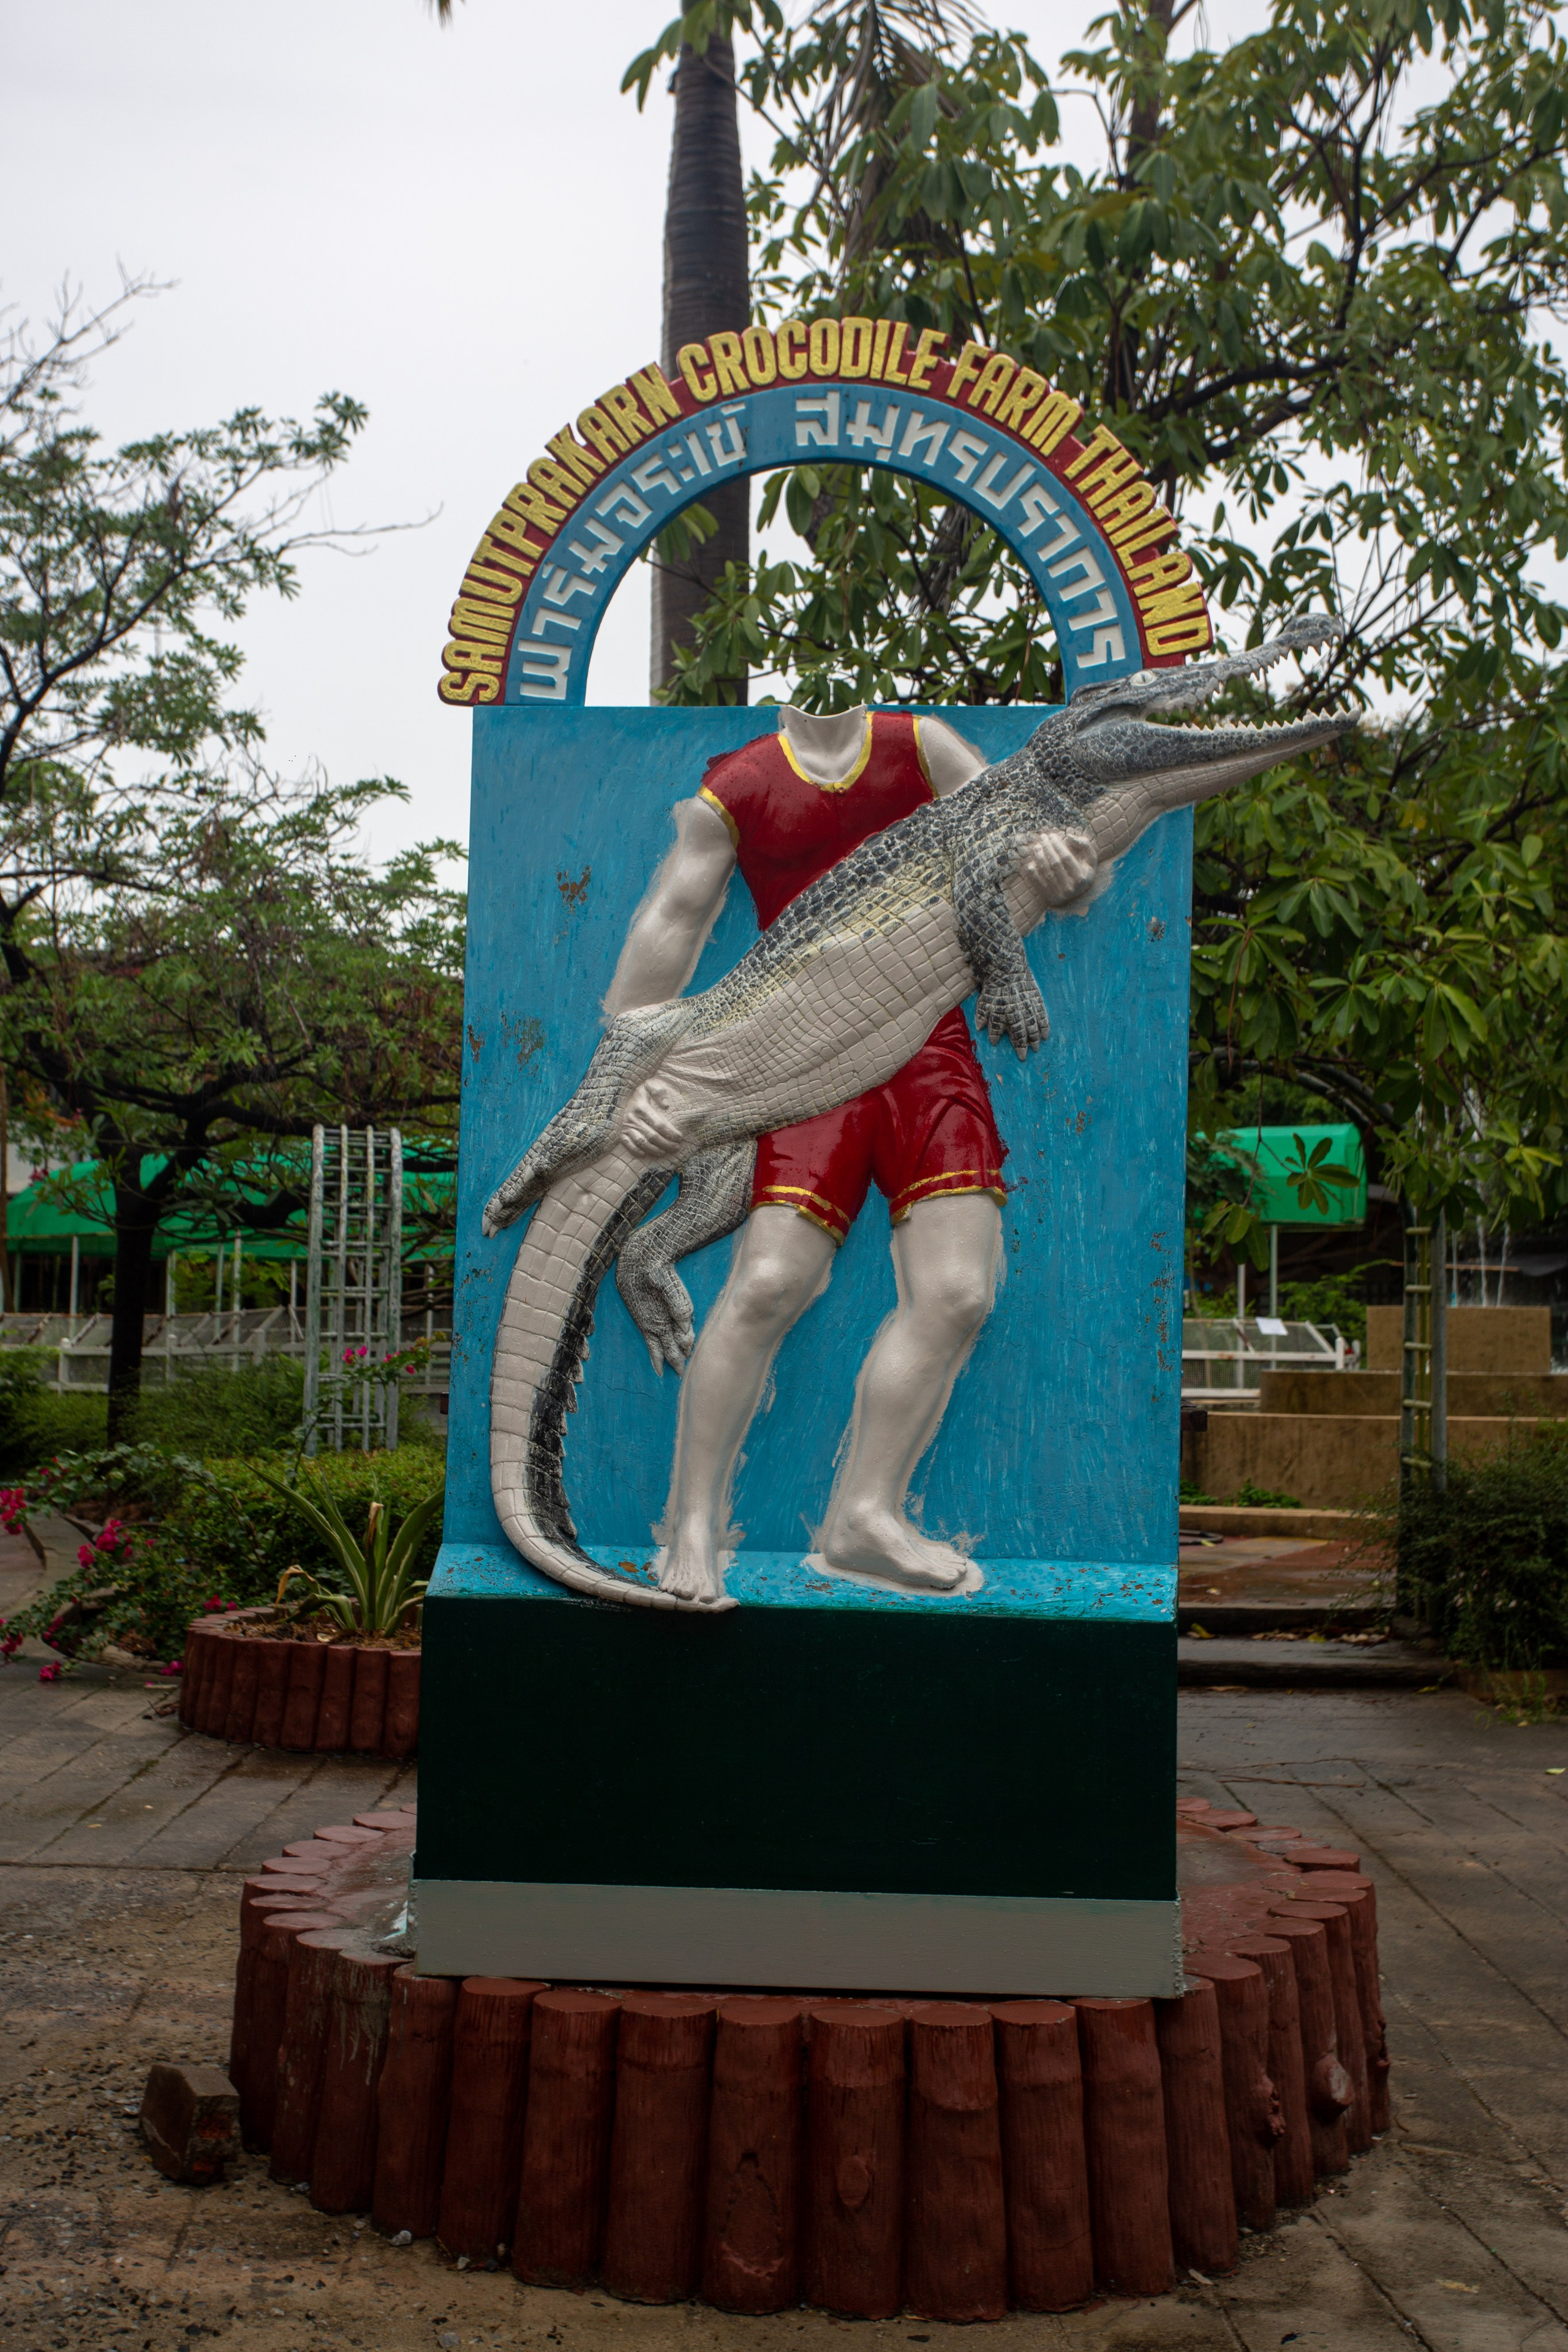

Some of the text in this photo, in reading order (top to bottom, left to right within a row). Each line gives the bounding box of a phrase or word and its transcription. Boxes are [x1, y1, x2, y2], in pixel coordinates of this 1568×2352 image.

[439, 317, 1212, 703] SAMUTPRAKARN CROCODILE FARM THAILAND
[796, 390, 1126, 668] สมุทรปราการ
